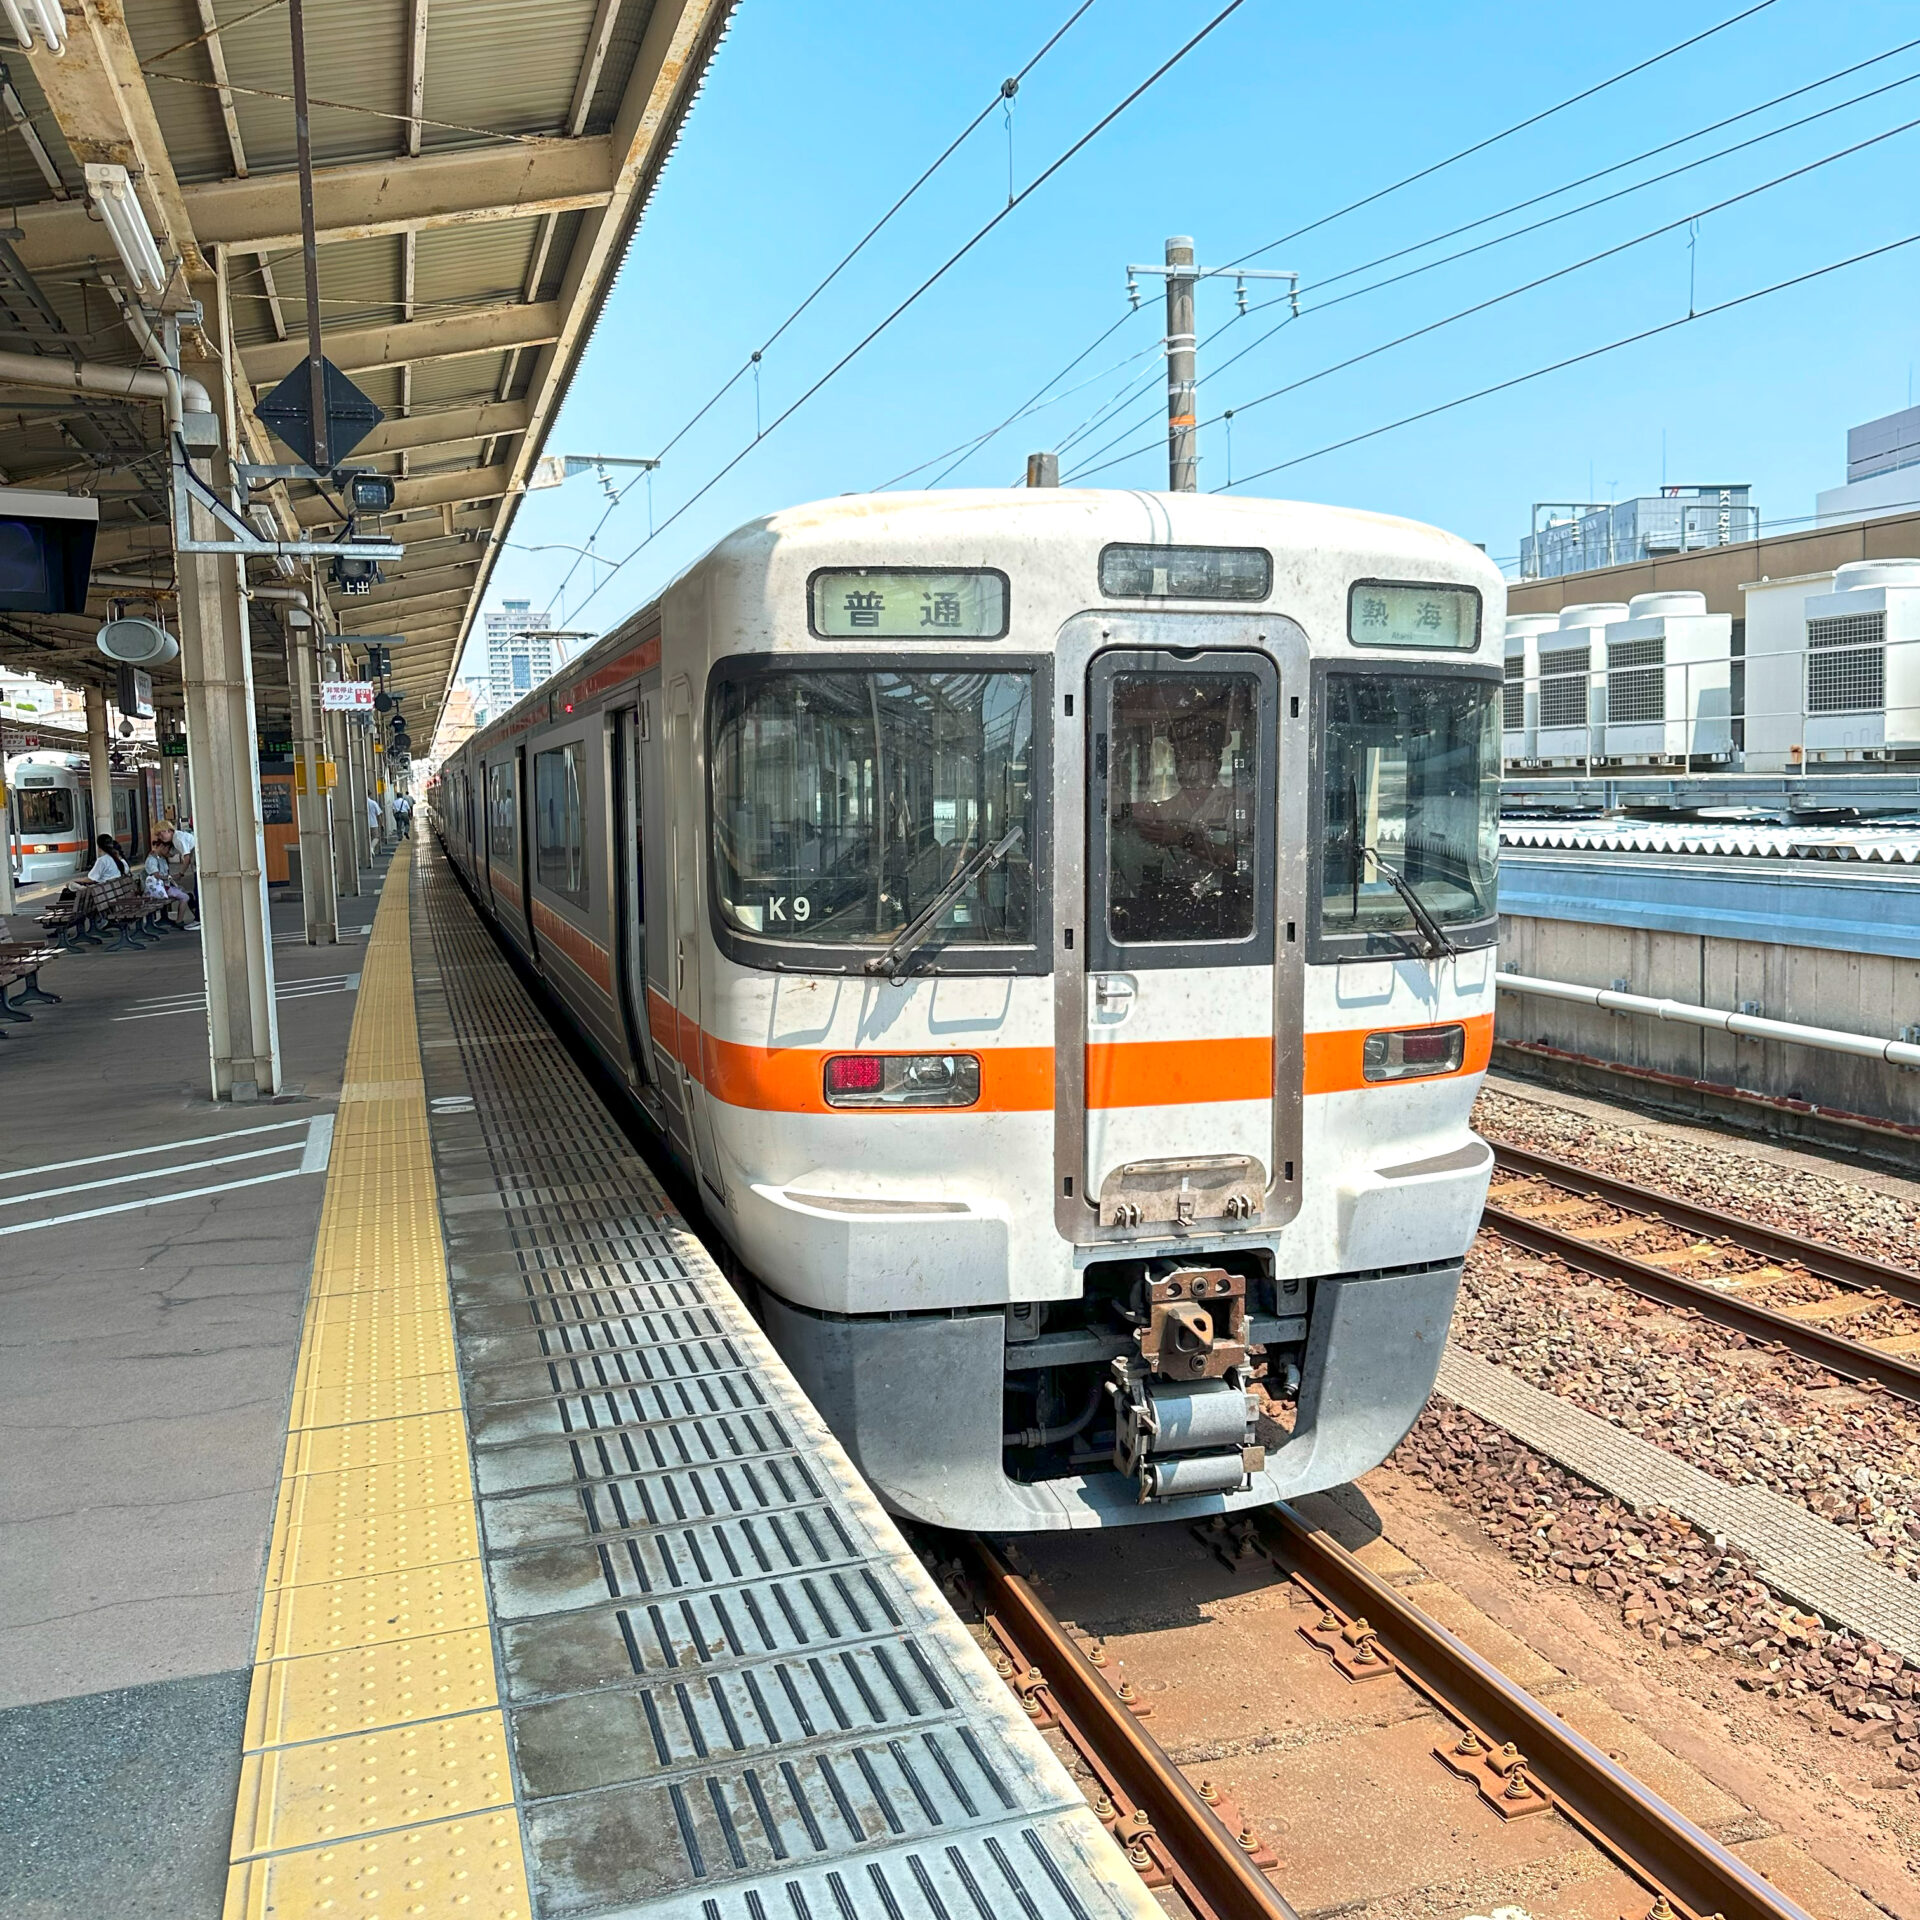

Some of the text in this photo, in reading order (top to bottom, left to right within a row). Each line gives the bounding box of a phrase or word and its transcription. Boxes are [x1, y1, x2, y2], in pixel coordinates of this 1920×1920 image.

[342, 581, 370, 595] 上出
[843, 590, 963, 628] 普通
[1362, 598, 1442, 630] 熱海
[326, 686, 354, 694] 非常停止
